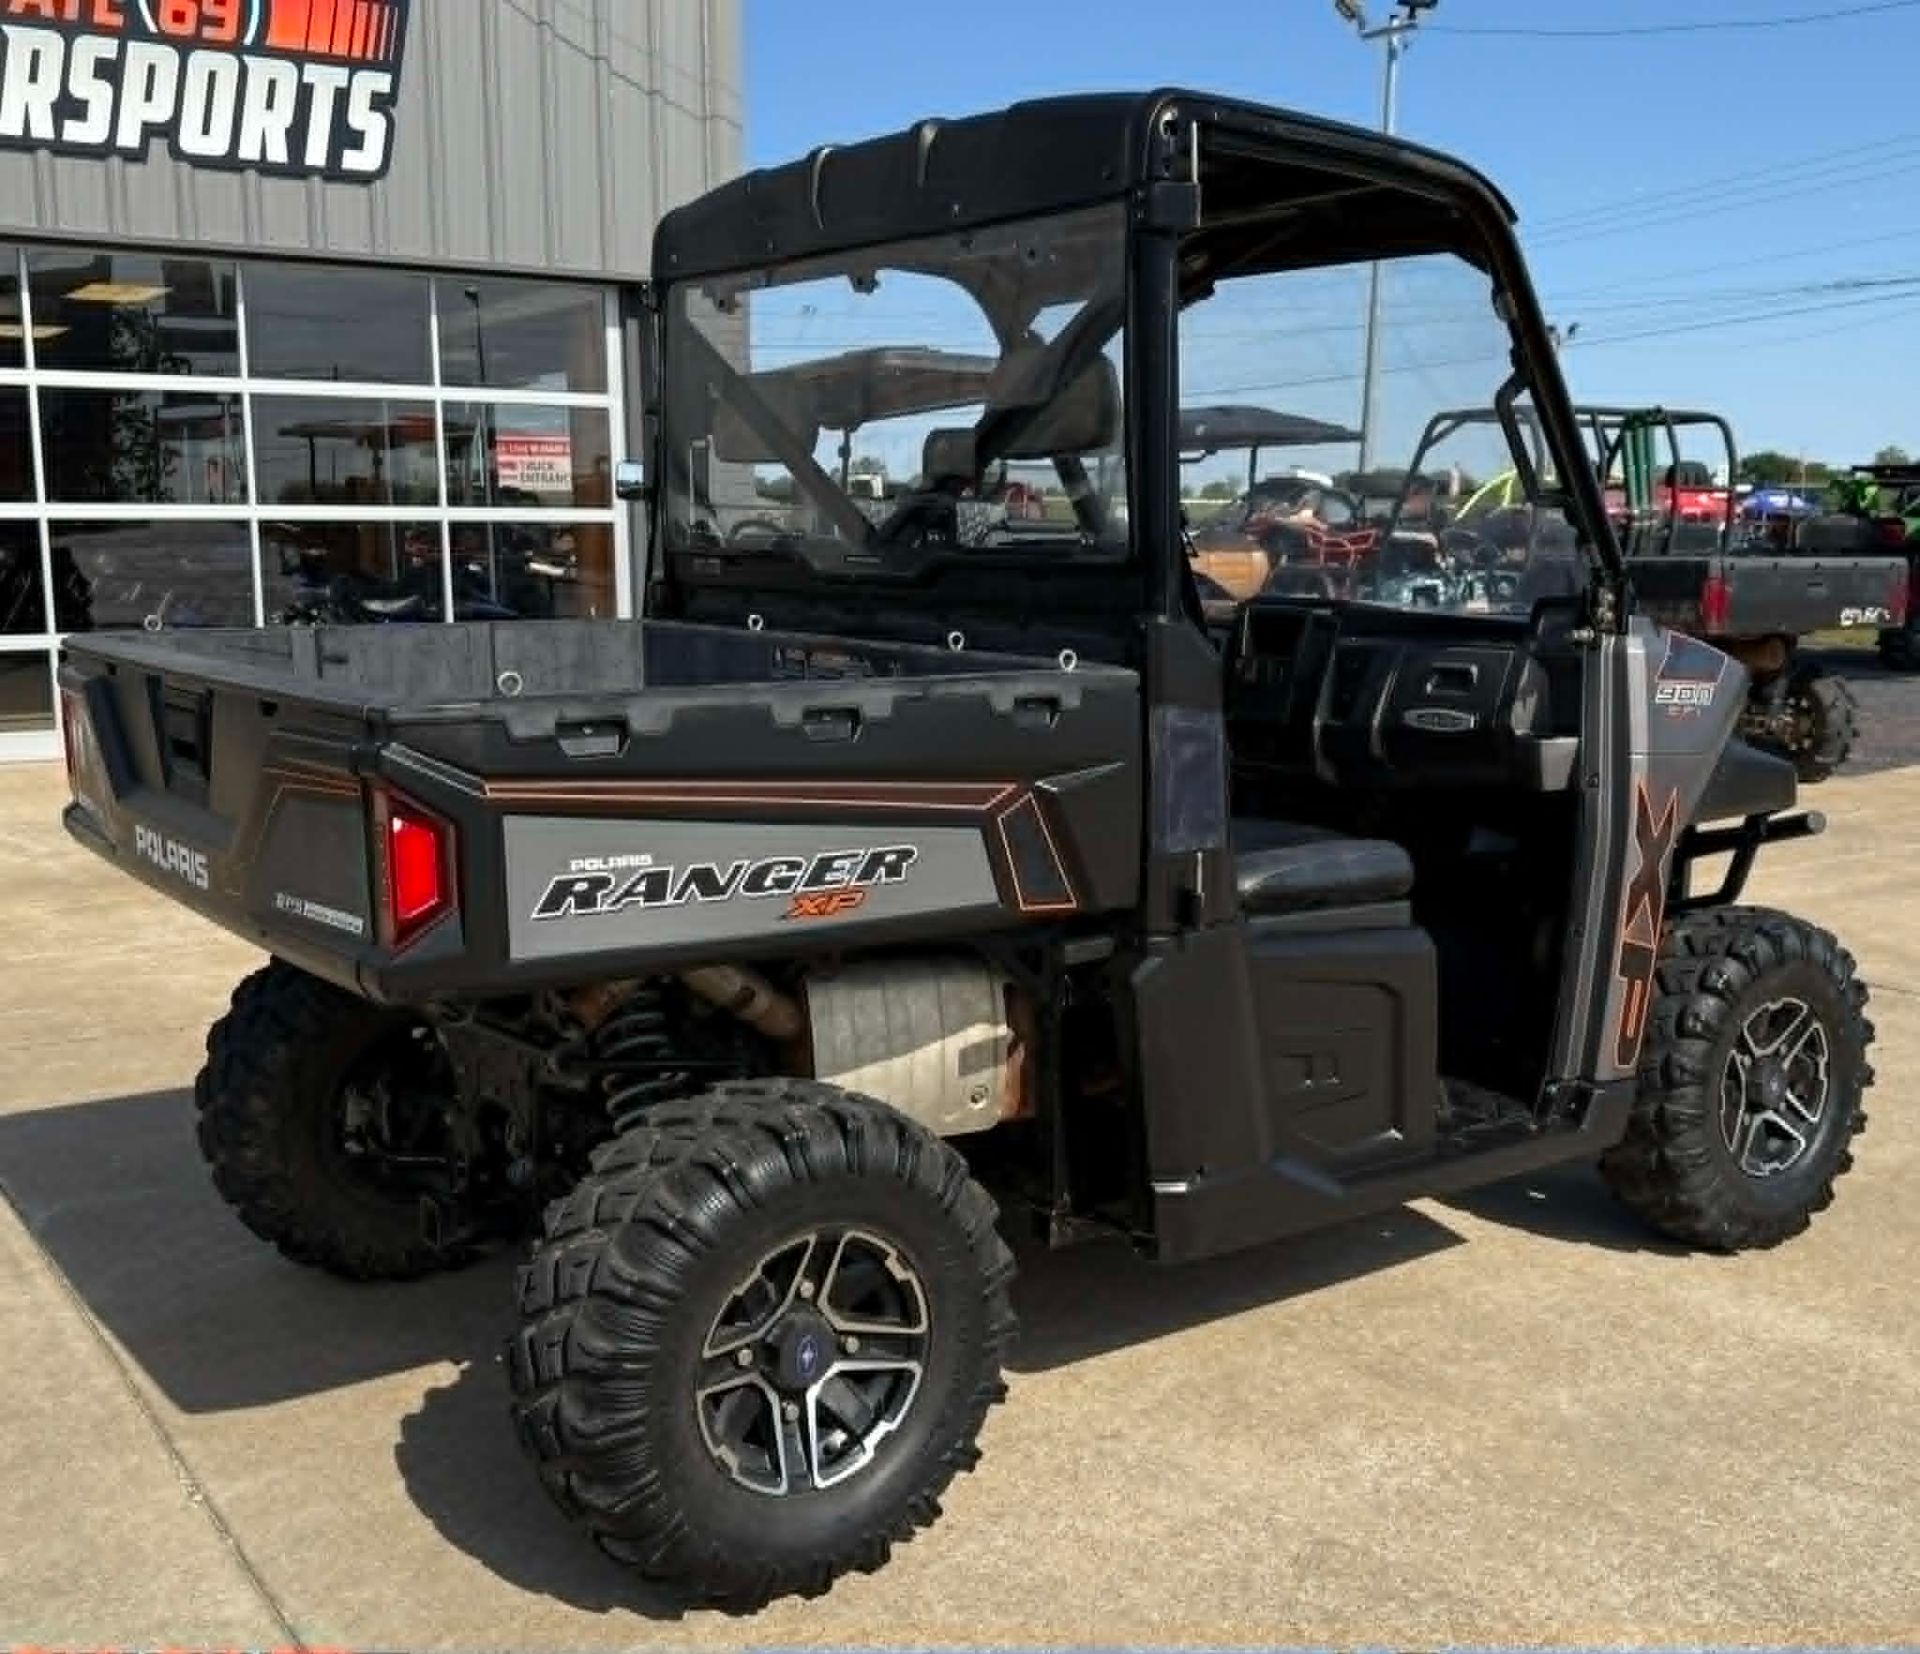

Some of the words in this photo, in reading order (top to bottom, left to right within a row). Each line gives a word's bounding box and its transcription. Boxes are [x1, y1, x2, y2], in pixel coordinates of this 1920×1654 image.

[0, 24, 393, 172] RSPORTS
[134, 824, 210, 890] POLARIS
[531, 844, 919, 921] RANGER
[569, 854, 654, 872] POLARIS
[784, 888, 866, 918] XP
